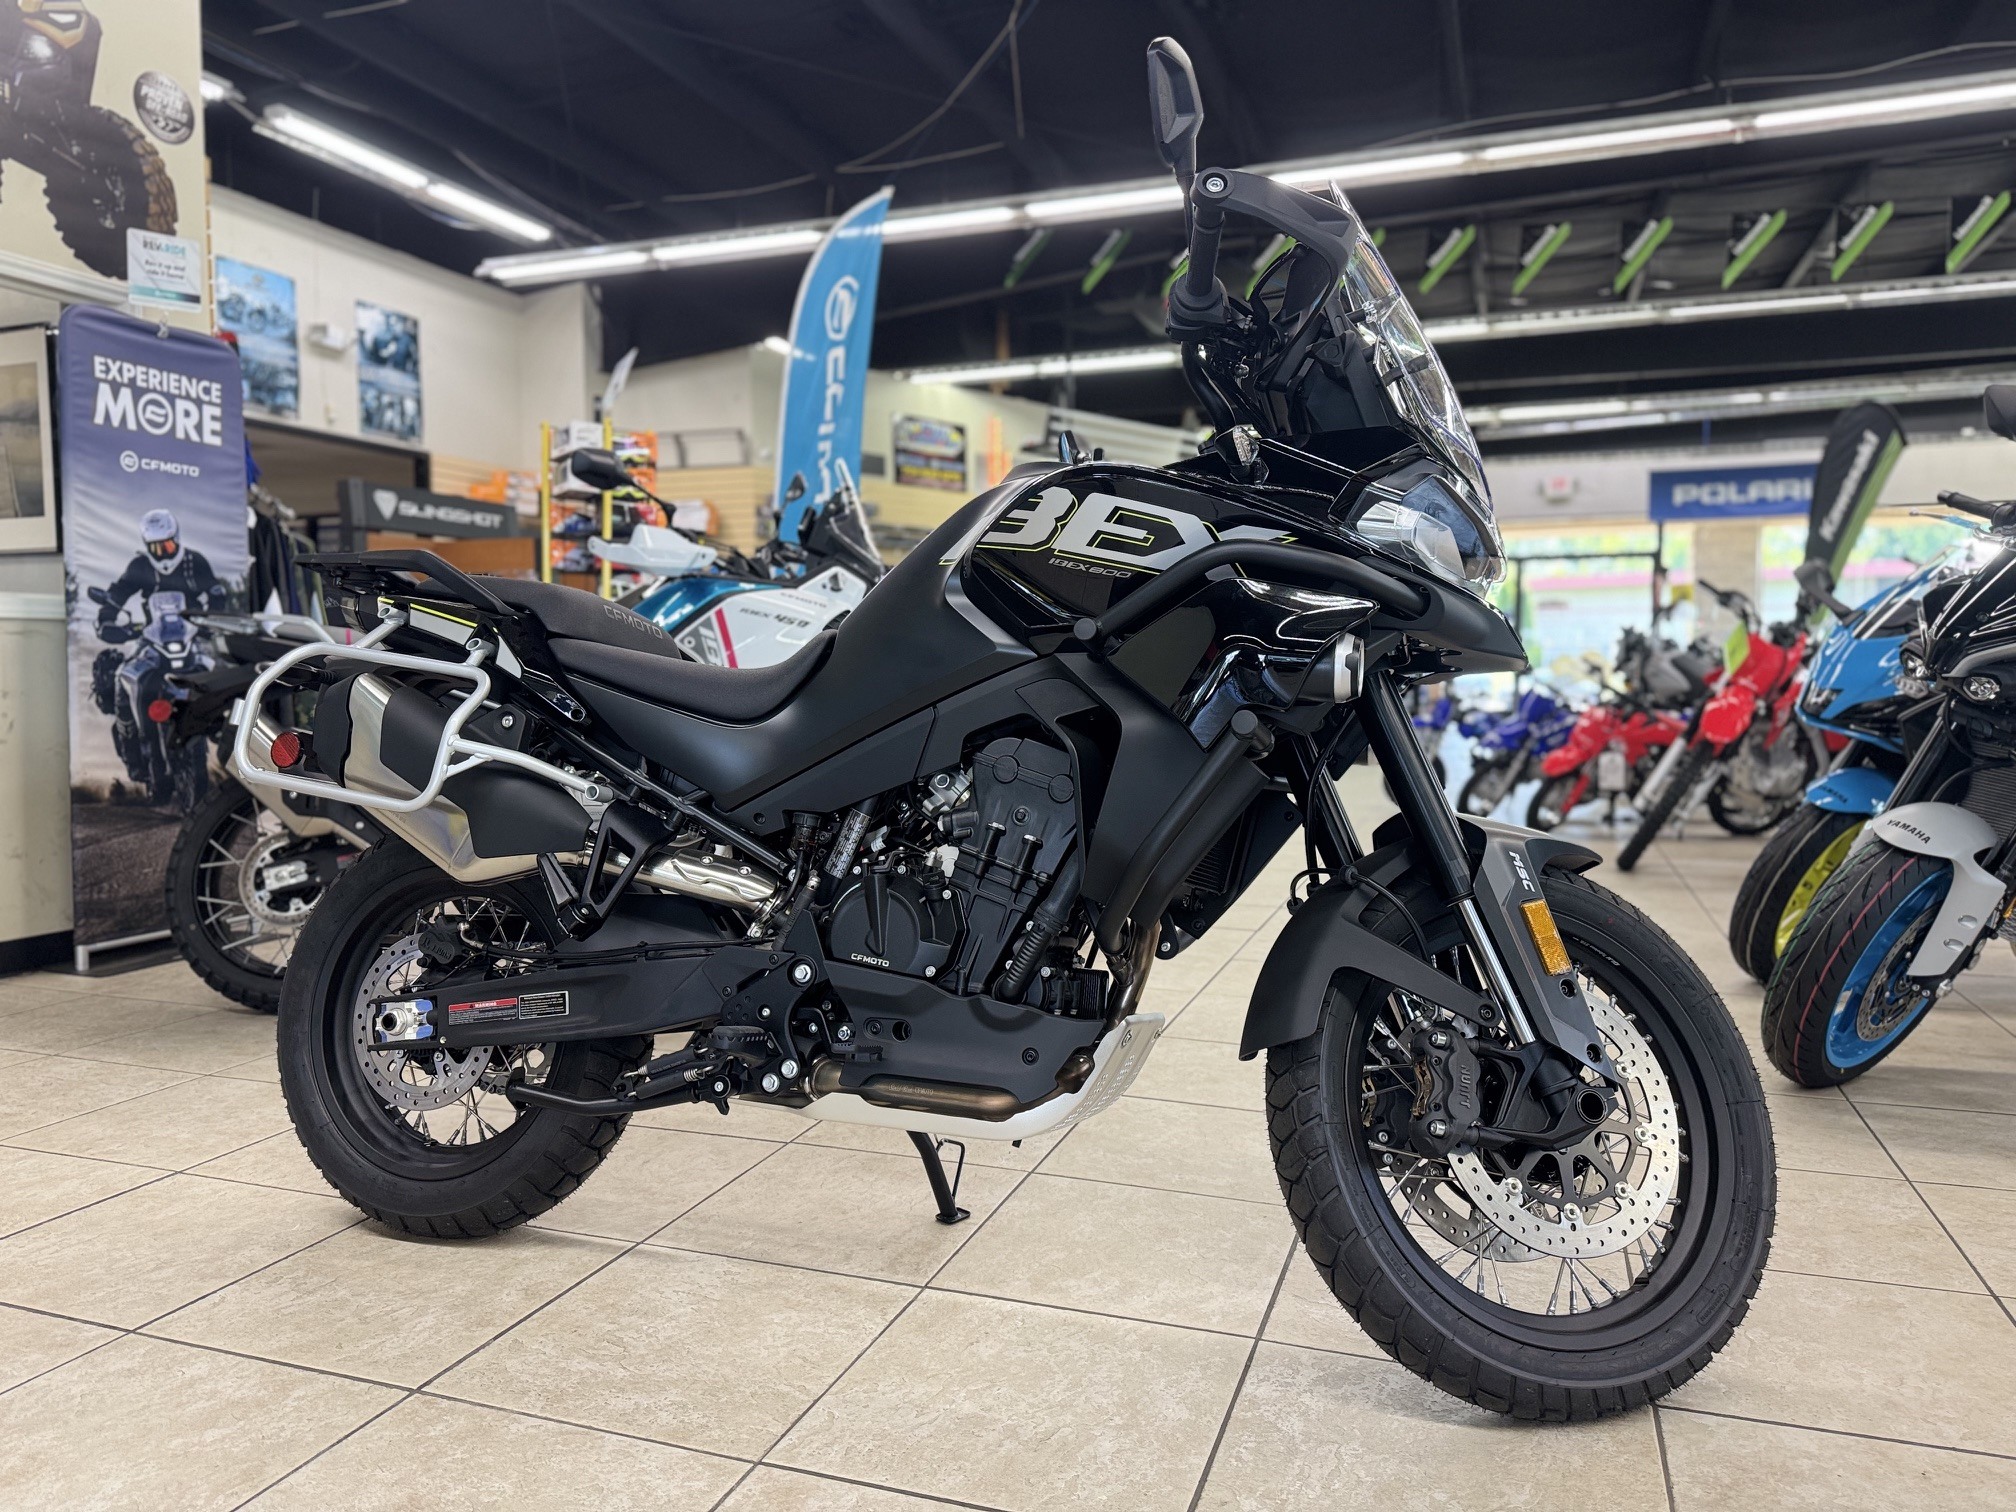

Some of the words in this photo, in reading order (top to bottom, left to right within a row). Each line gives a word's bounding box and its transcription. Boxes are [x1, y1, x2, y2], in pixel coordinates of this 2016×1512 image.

[94, 355, 222, 404] EXPERIENCE
[94, 382, 222, 446] MORE
[141, 458, 199, 477] CFMOTO
[1672, 477, 1813, 507] POLARI
[398, 500, 503, 529] SLINGSHOT
[603, 604, 663, 639] CFMOTO
[1887, 819, 1932, 844] YAMAHA
[1508, 850, 1536, 893] MSC
[851, 953, 890, 967] CFMOTO
